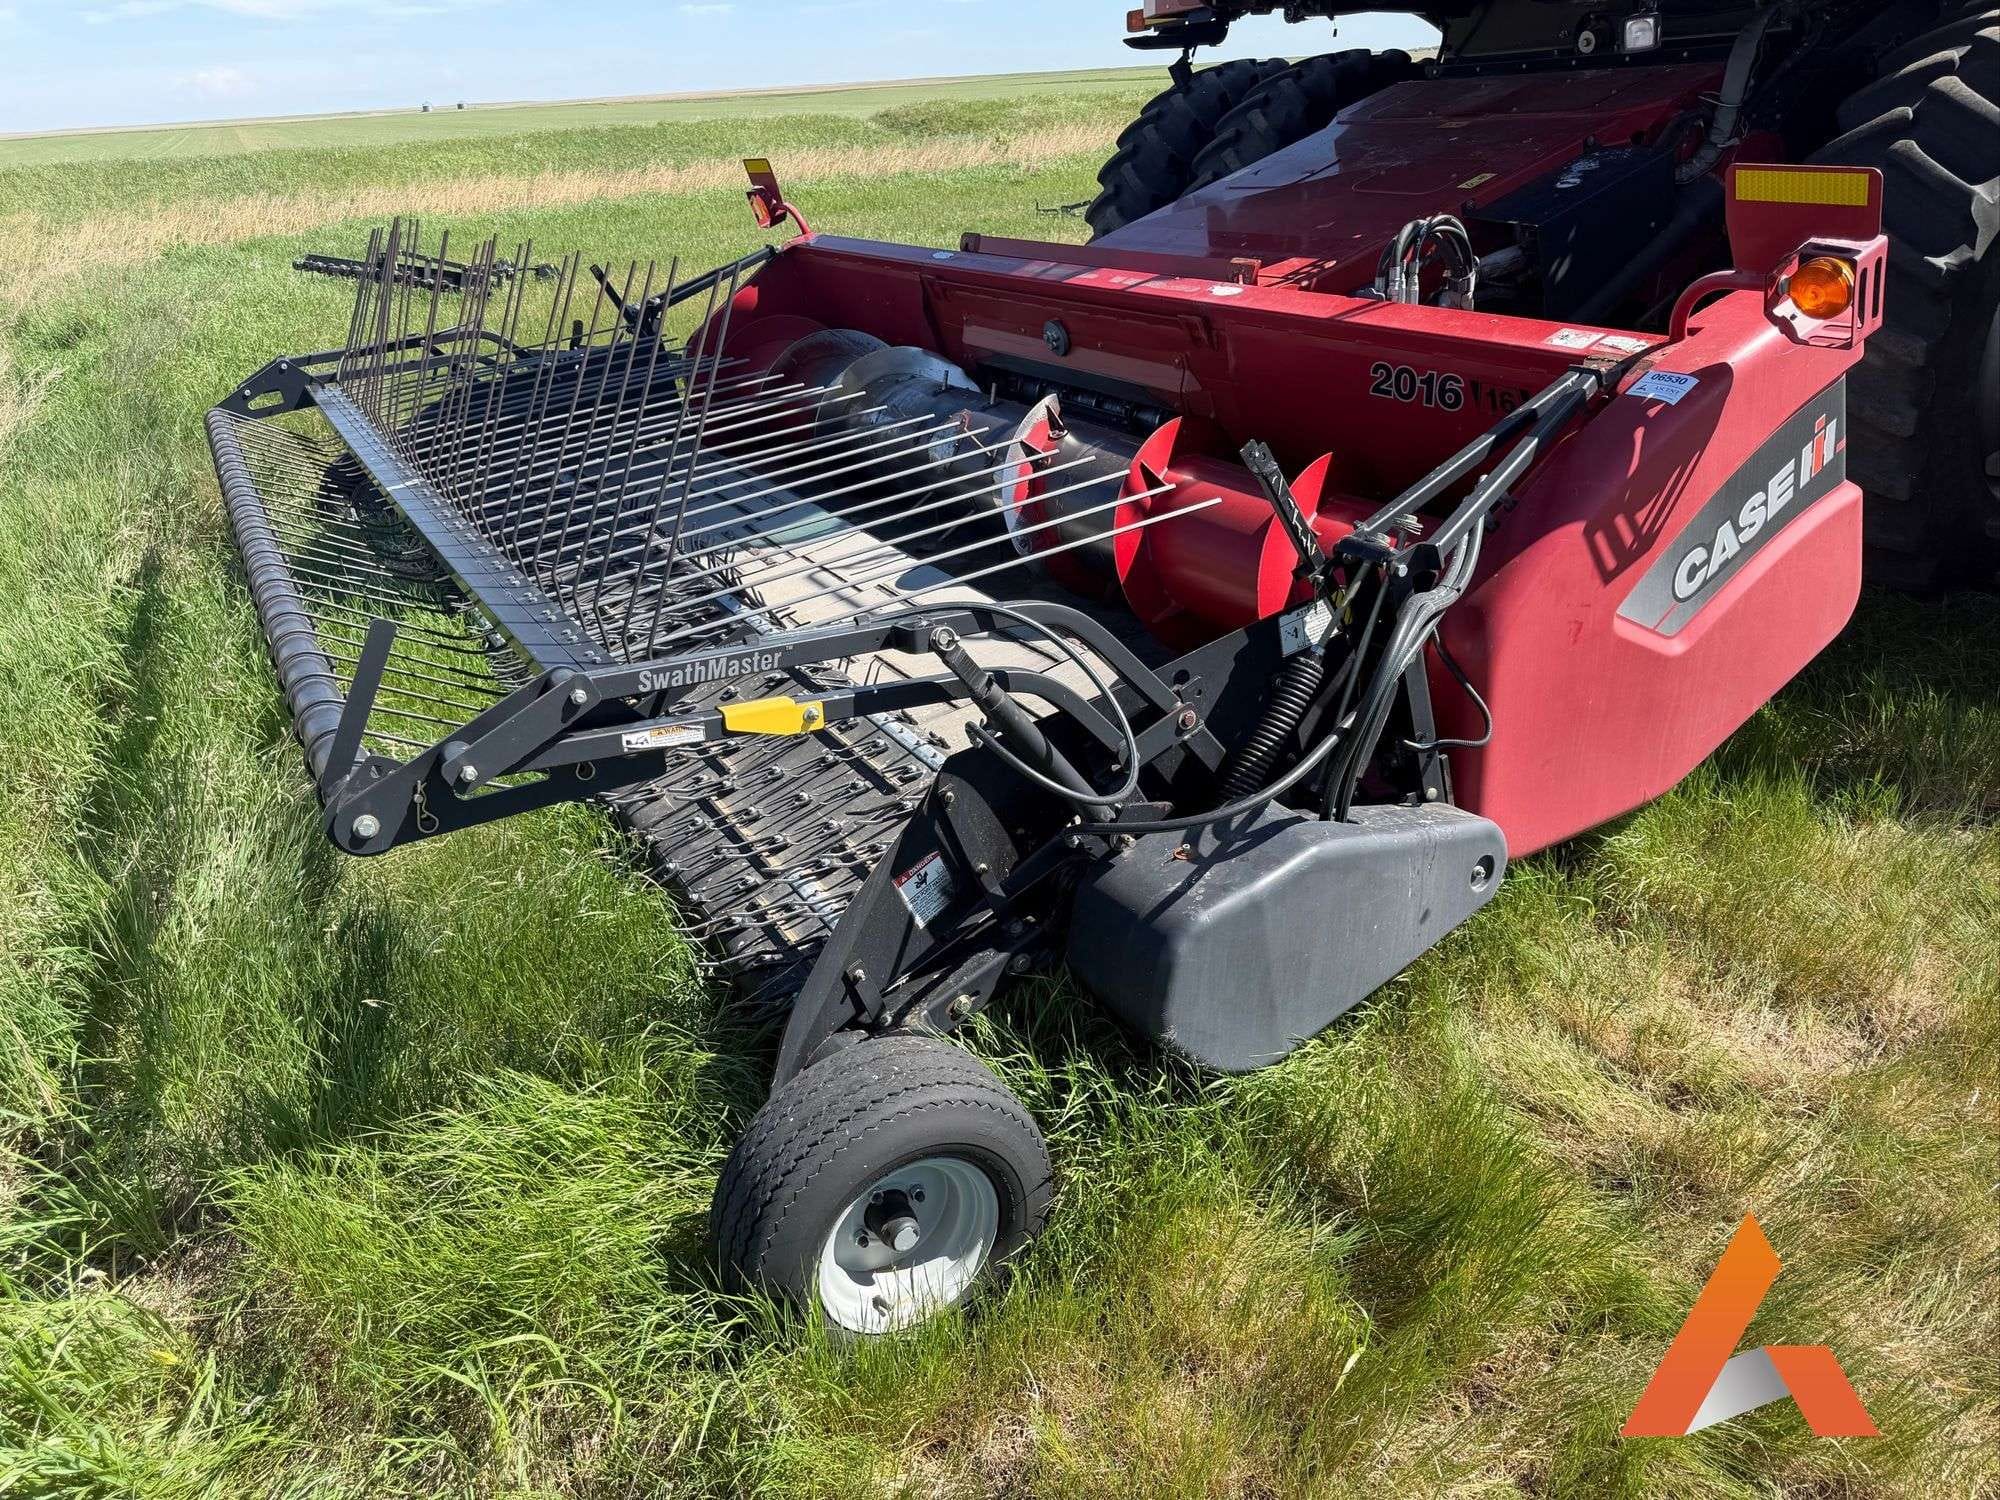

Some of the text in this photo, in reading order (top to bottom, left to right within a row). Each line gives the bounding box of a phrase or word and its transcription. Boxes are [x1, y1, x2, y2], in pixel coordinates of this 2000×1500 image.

[1369, 361, 1465, 412] 2016
[1650, 373, 1689, 386] 06530
[1673, 458, 1796, 601] CASE
[637, 650, 783, 692] SwathMaster
